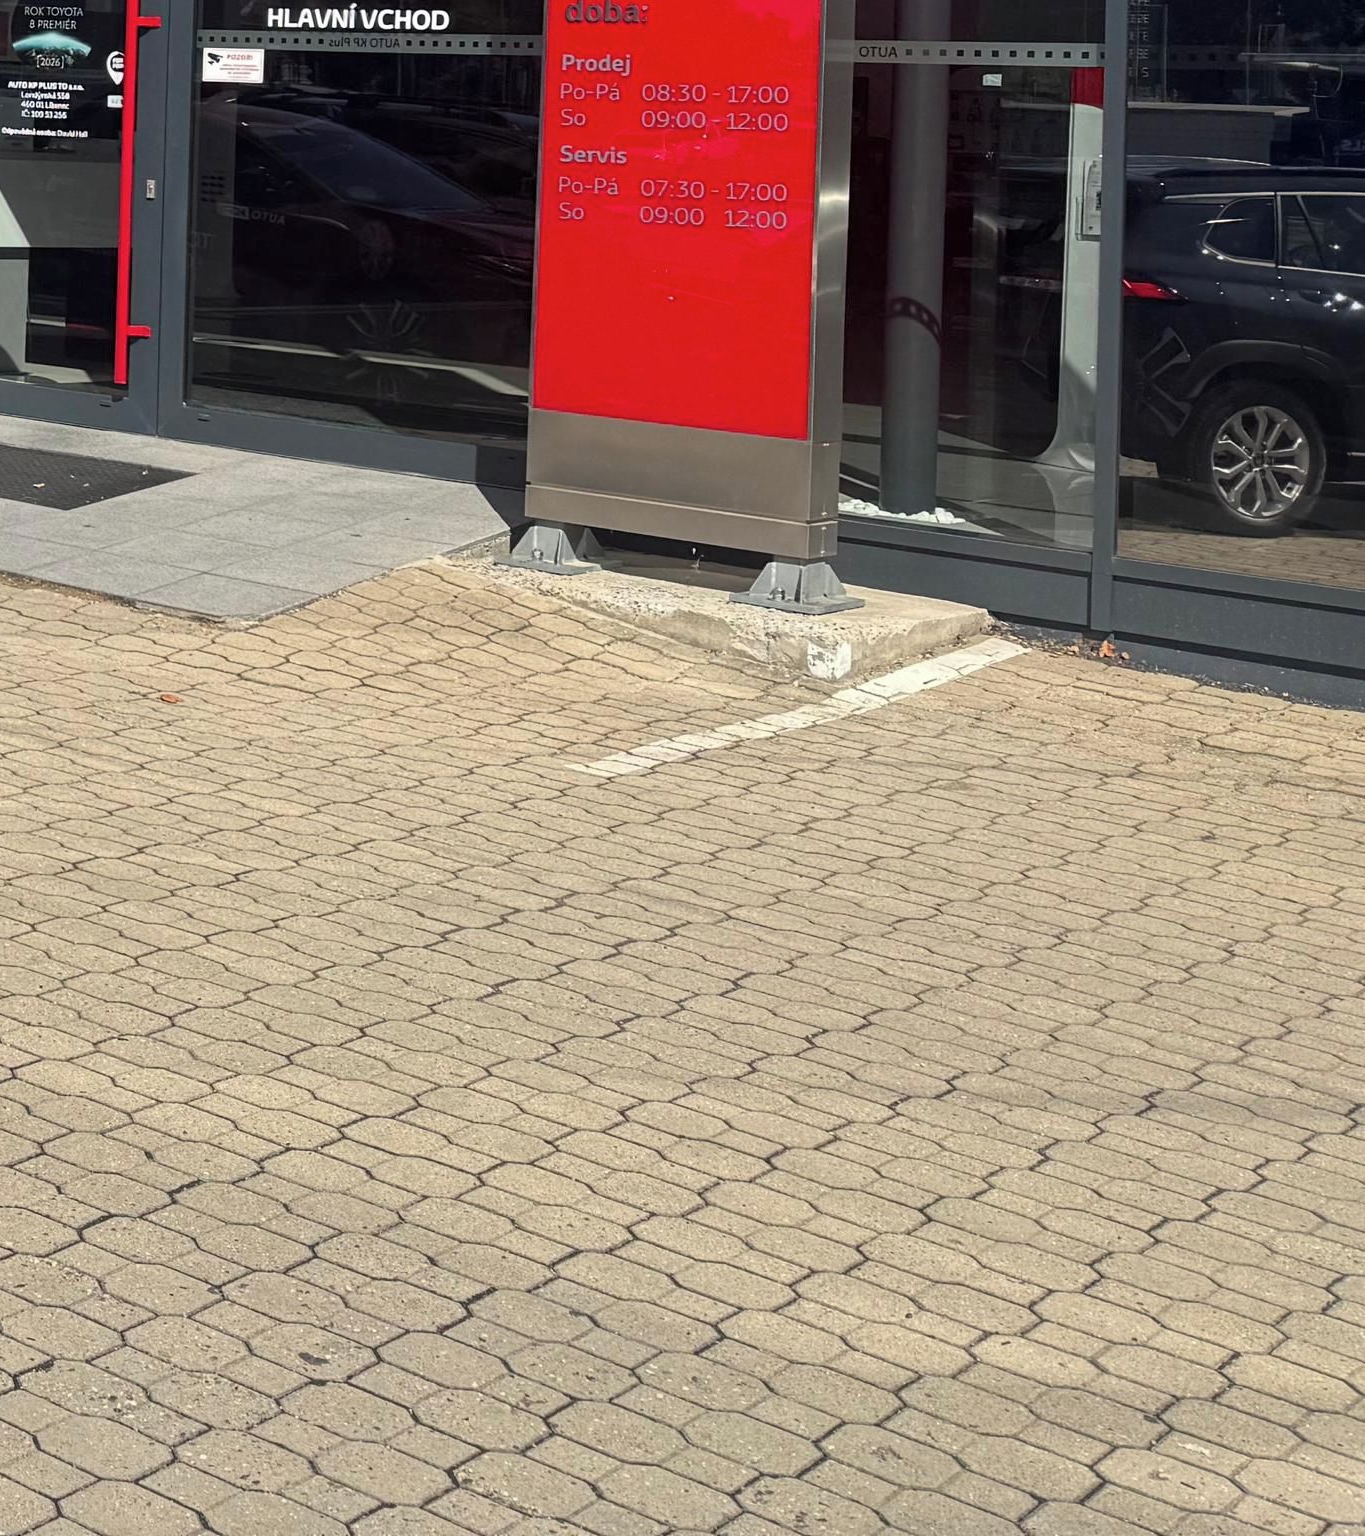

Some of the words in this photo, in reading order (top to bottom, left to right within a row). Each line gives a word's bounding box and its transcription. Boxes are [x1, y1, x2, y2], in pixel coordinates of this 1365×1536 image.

[24, 7, 46, 16] ROK
[47, 7, 83, 16] TOYOTA
[268, 3, 357, 29] HLAVNÍ
[360, 9, 450, 30] VCHOD
[37, 19, 77, 30] PREMIÉR
[561, 54, 631, 76] Prodej
[560, 82, 620, 100] Po-Pá
[642, 84, 706, 102] 08:30
[727, 85, 789, 104] 17:00
[561, 109, 586, 126] So
[641, 110, 706, 129] 09:00
[726, 113, 789, 131] 12:00
[559, 145, 627, 164] Servis
[558, 176, 619, 195] Po-Pá
[640, 180, 705, 199] 07:30
[726, 182, 787, 202] 17:00
[559, 202, 584, 220] So
[640, 206, 704, 225] 09:00
[724, 210, 787, 230] 12:00
